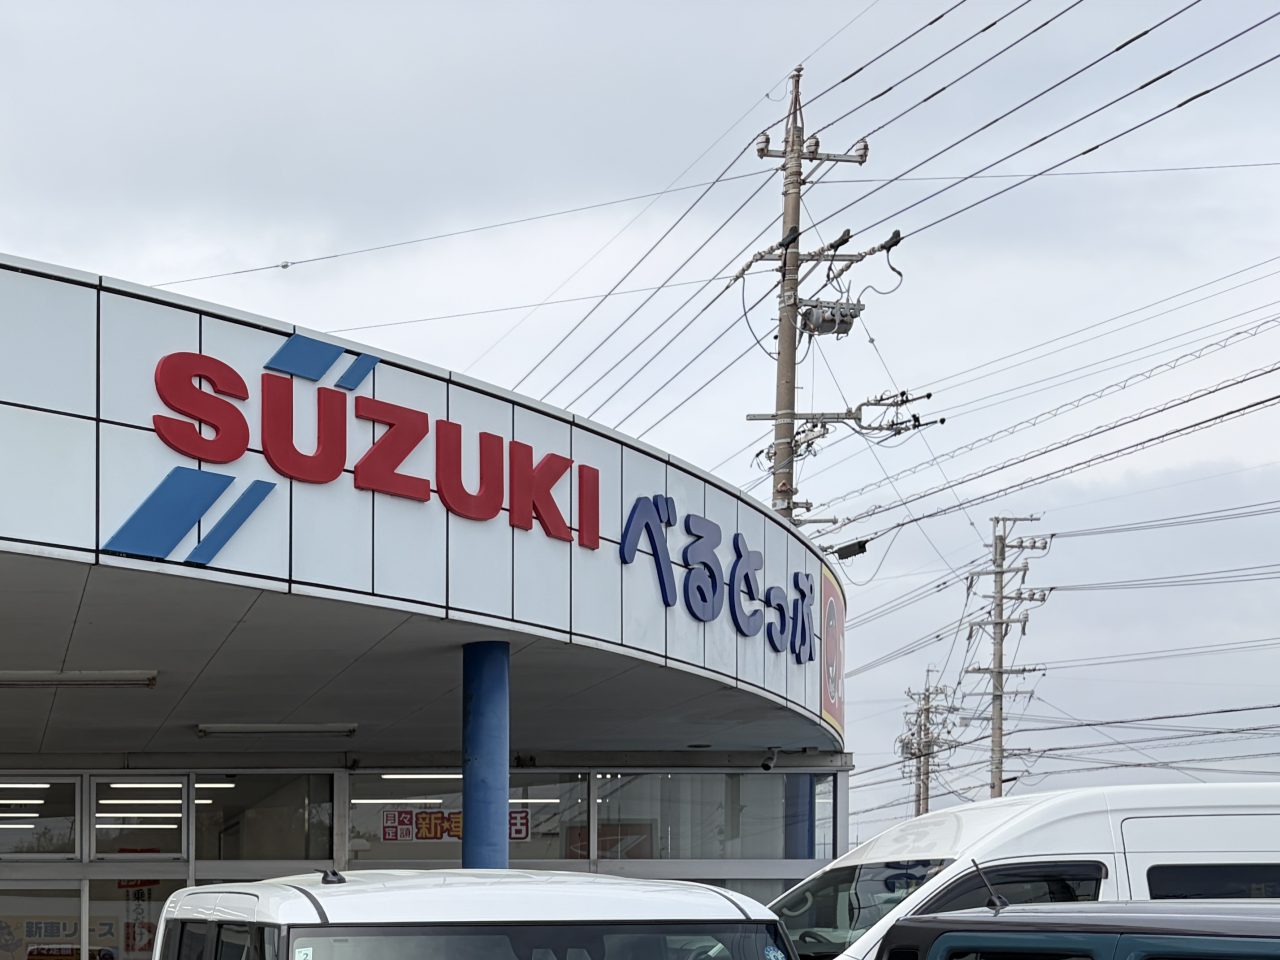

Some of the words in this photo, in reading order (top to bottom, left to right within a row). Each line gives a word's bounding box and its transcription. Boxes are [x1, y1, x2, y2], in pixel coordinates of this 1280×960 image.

[153, 352, 600, 550] SUZUKI
[620, 494, 816, 665] べるとっぷ
